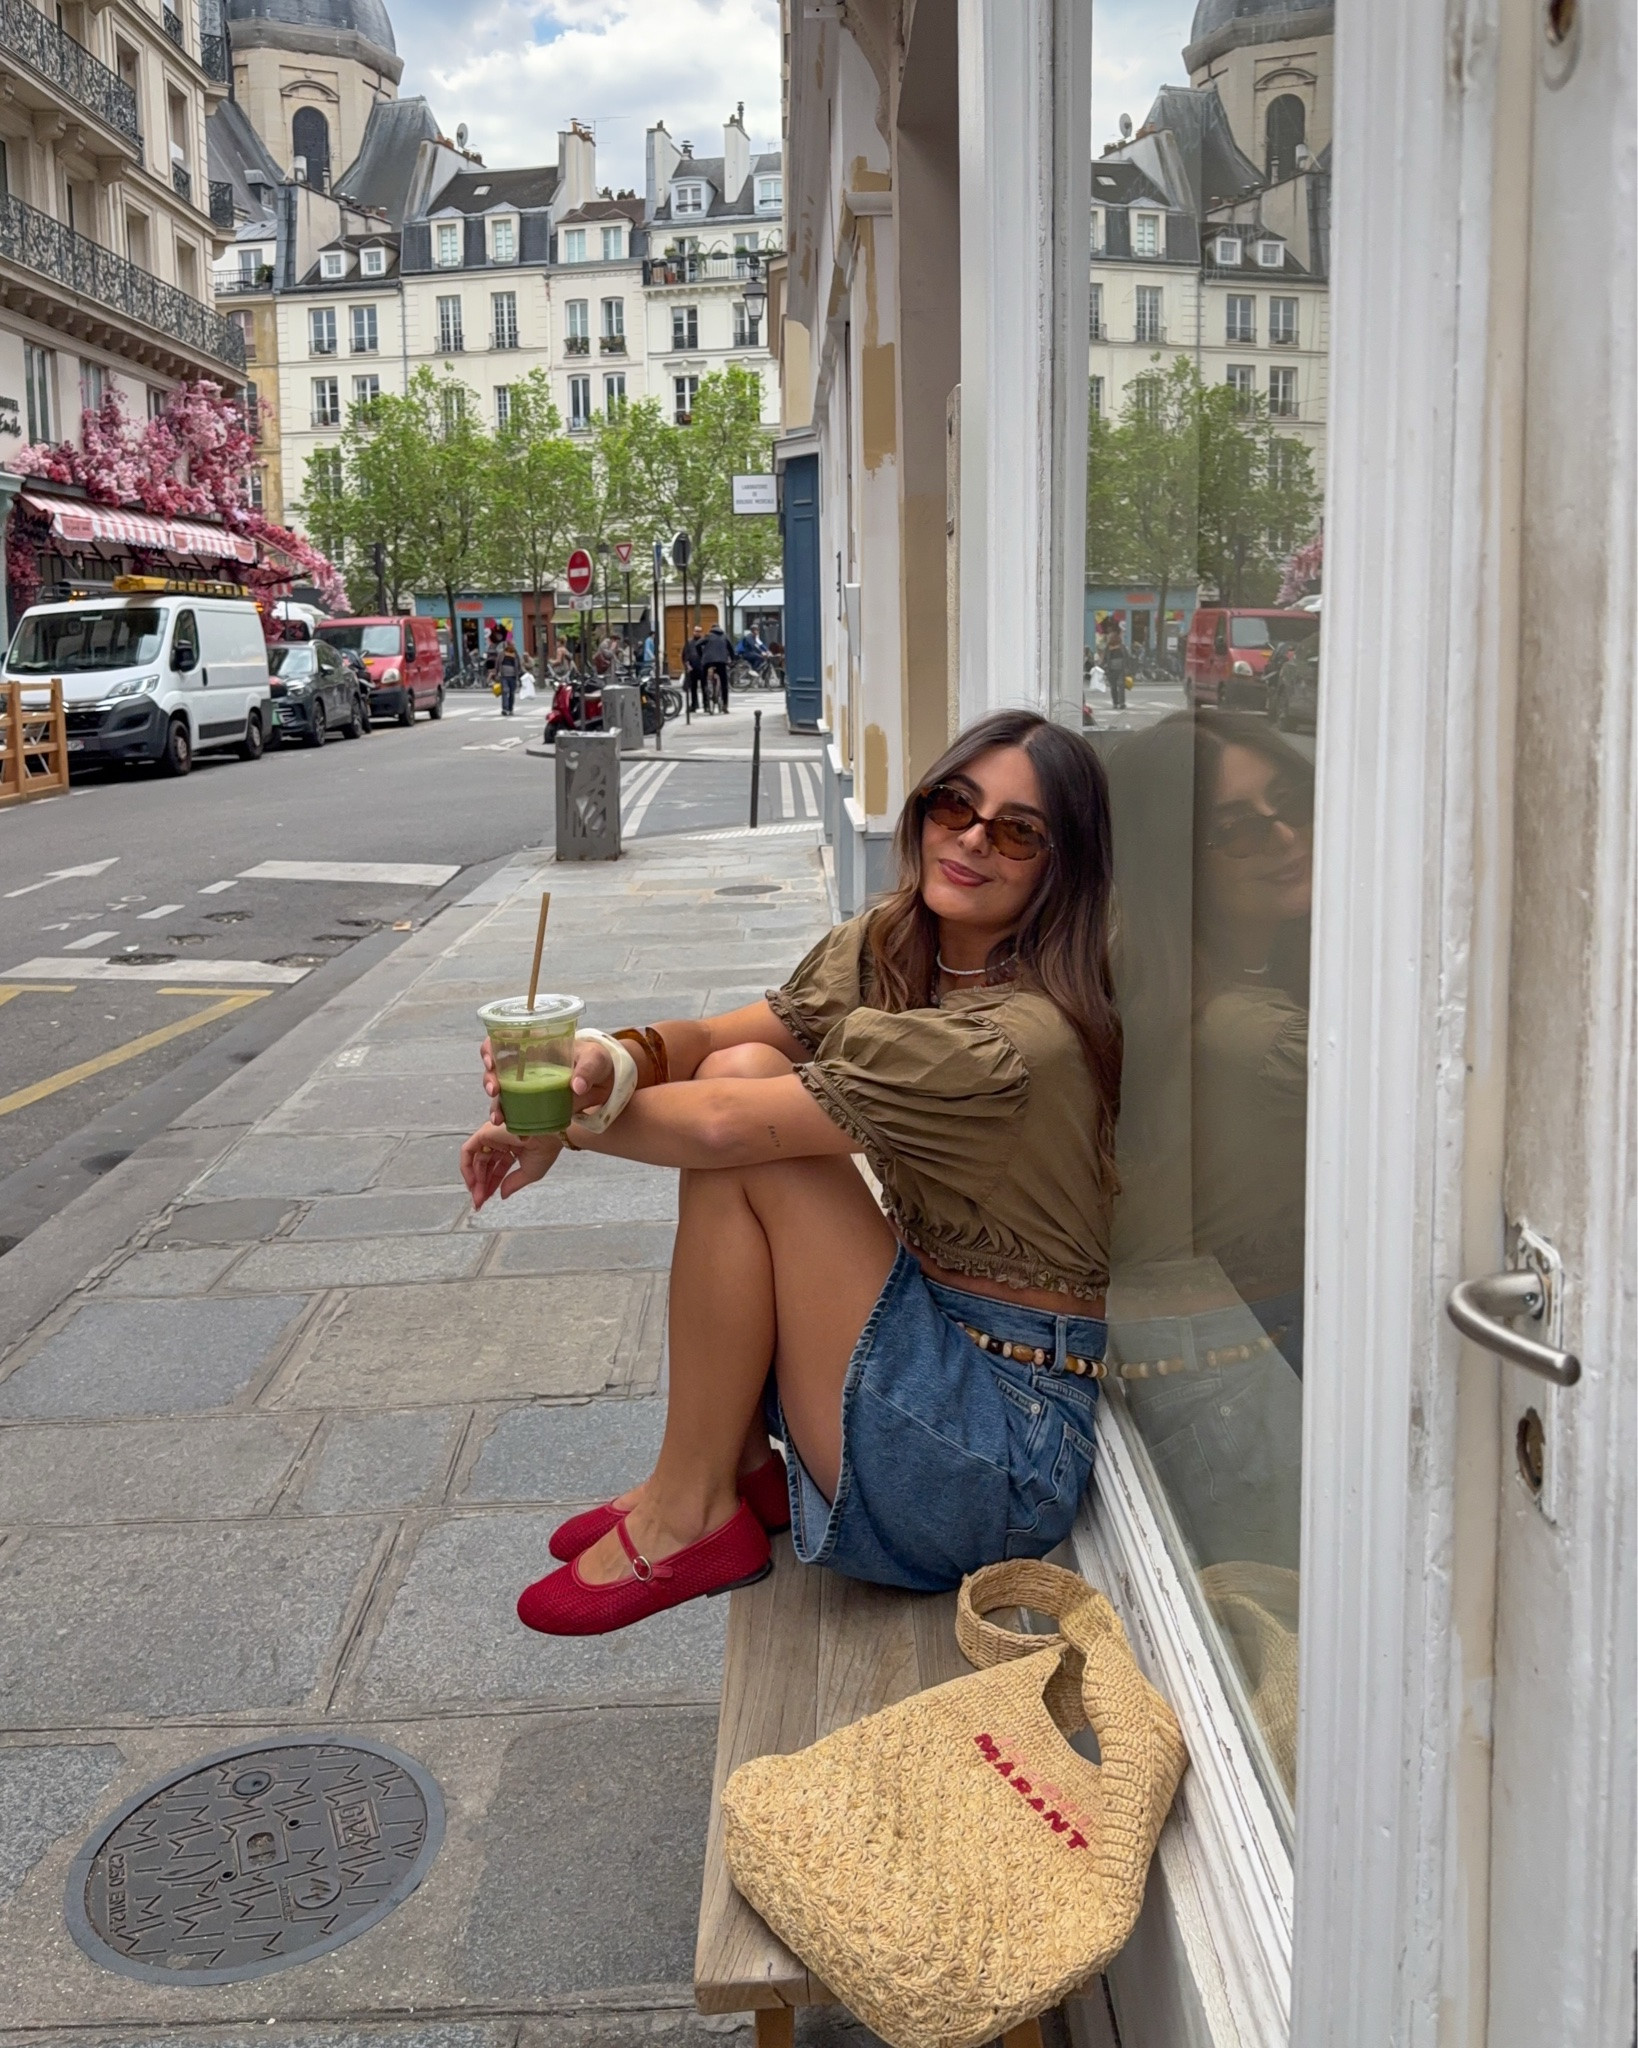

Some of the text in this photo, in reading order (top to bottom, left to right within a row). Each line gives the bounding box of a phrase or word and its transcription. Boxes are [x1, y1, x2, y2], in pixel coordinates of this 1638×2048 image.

[974, 1733, 1089, 1849] MARANT
[339, 1804, 372, 1844] GAZ
[108, 1853, 125, 1888] C250
